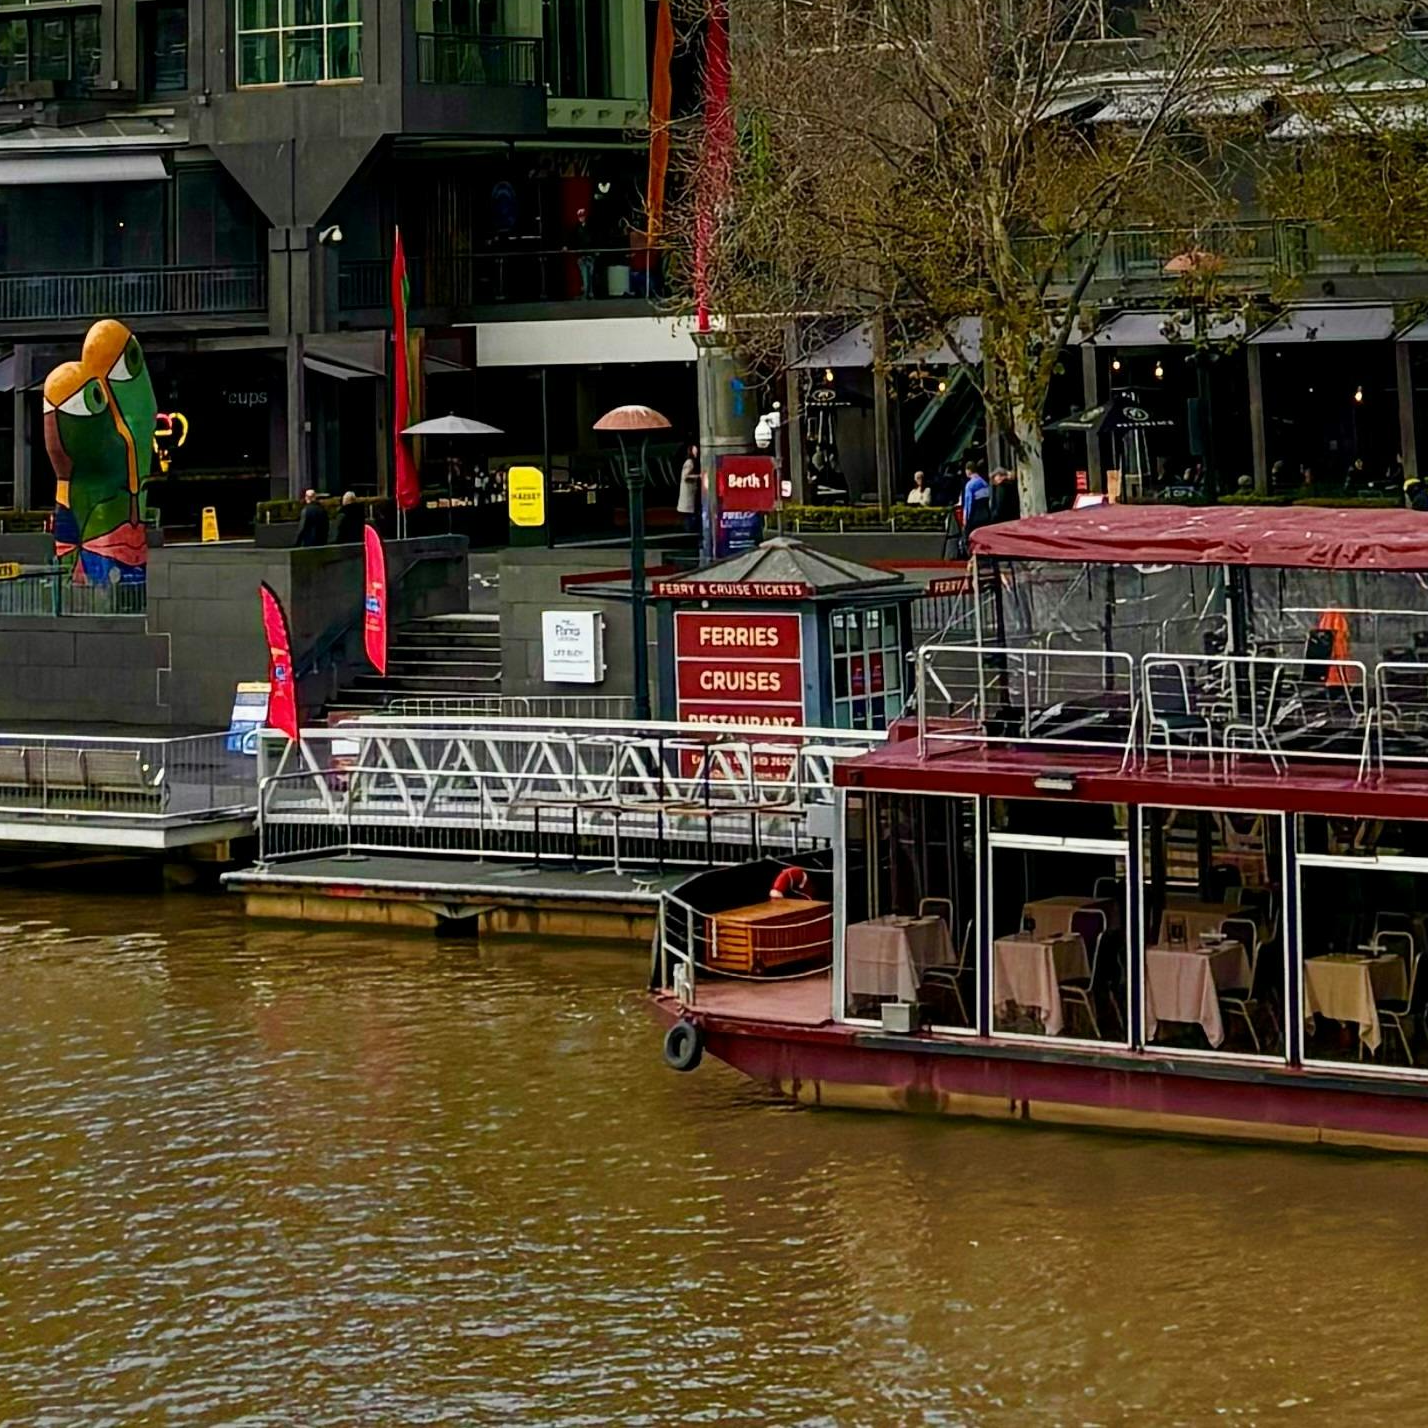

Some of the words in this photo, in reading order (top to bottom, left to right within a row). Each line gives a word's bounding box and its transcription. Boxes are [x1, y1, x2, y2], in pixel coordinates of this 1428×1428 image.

[728, 473, 760, 488] Berth
[763, 473, 770, 488] 1
[659, 583, 695, 595] FERRY
[699, 584, 706, 594] &
[709, 584, 751, 595] CRUISE
[753, 584, 802, 596] TICKETS
[699, 626, 779, 646] FERRIES
[699, 670, 781, 692] CRUISES
